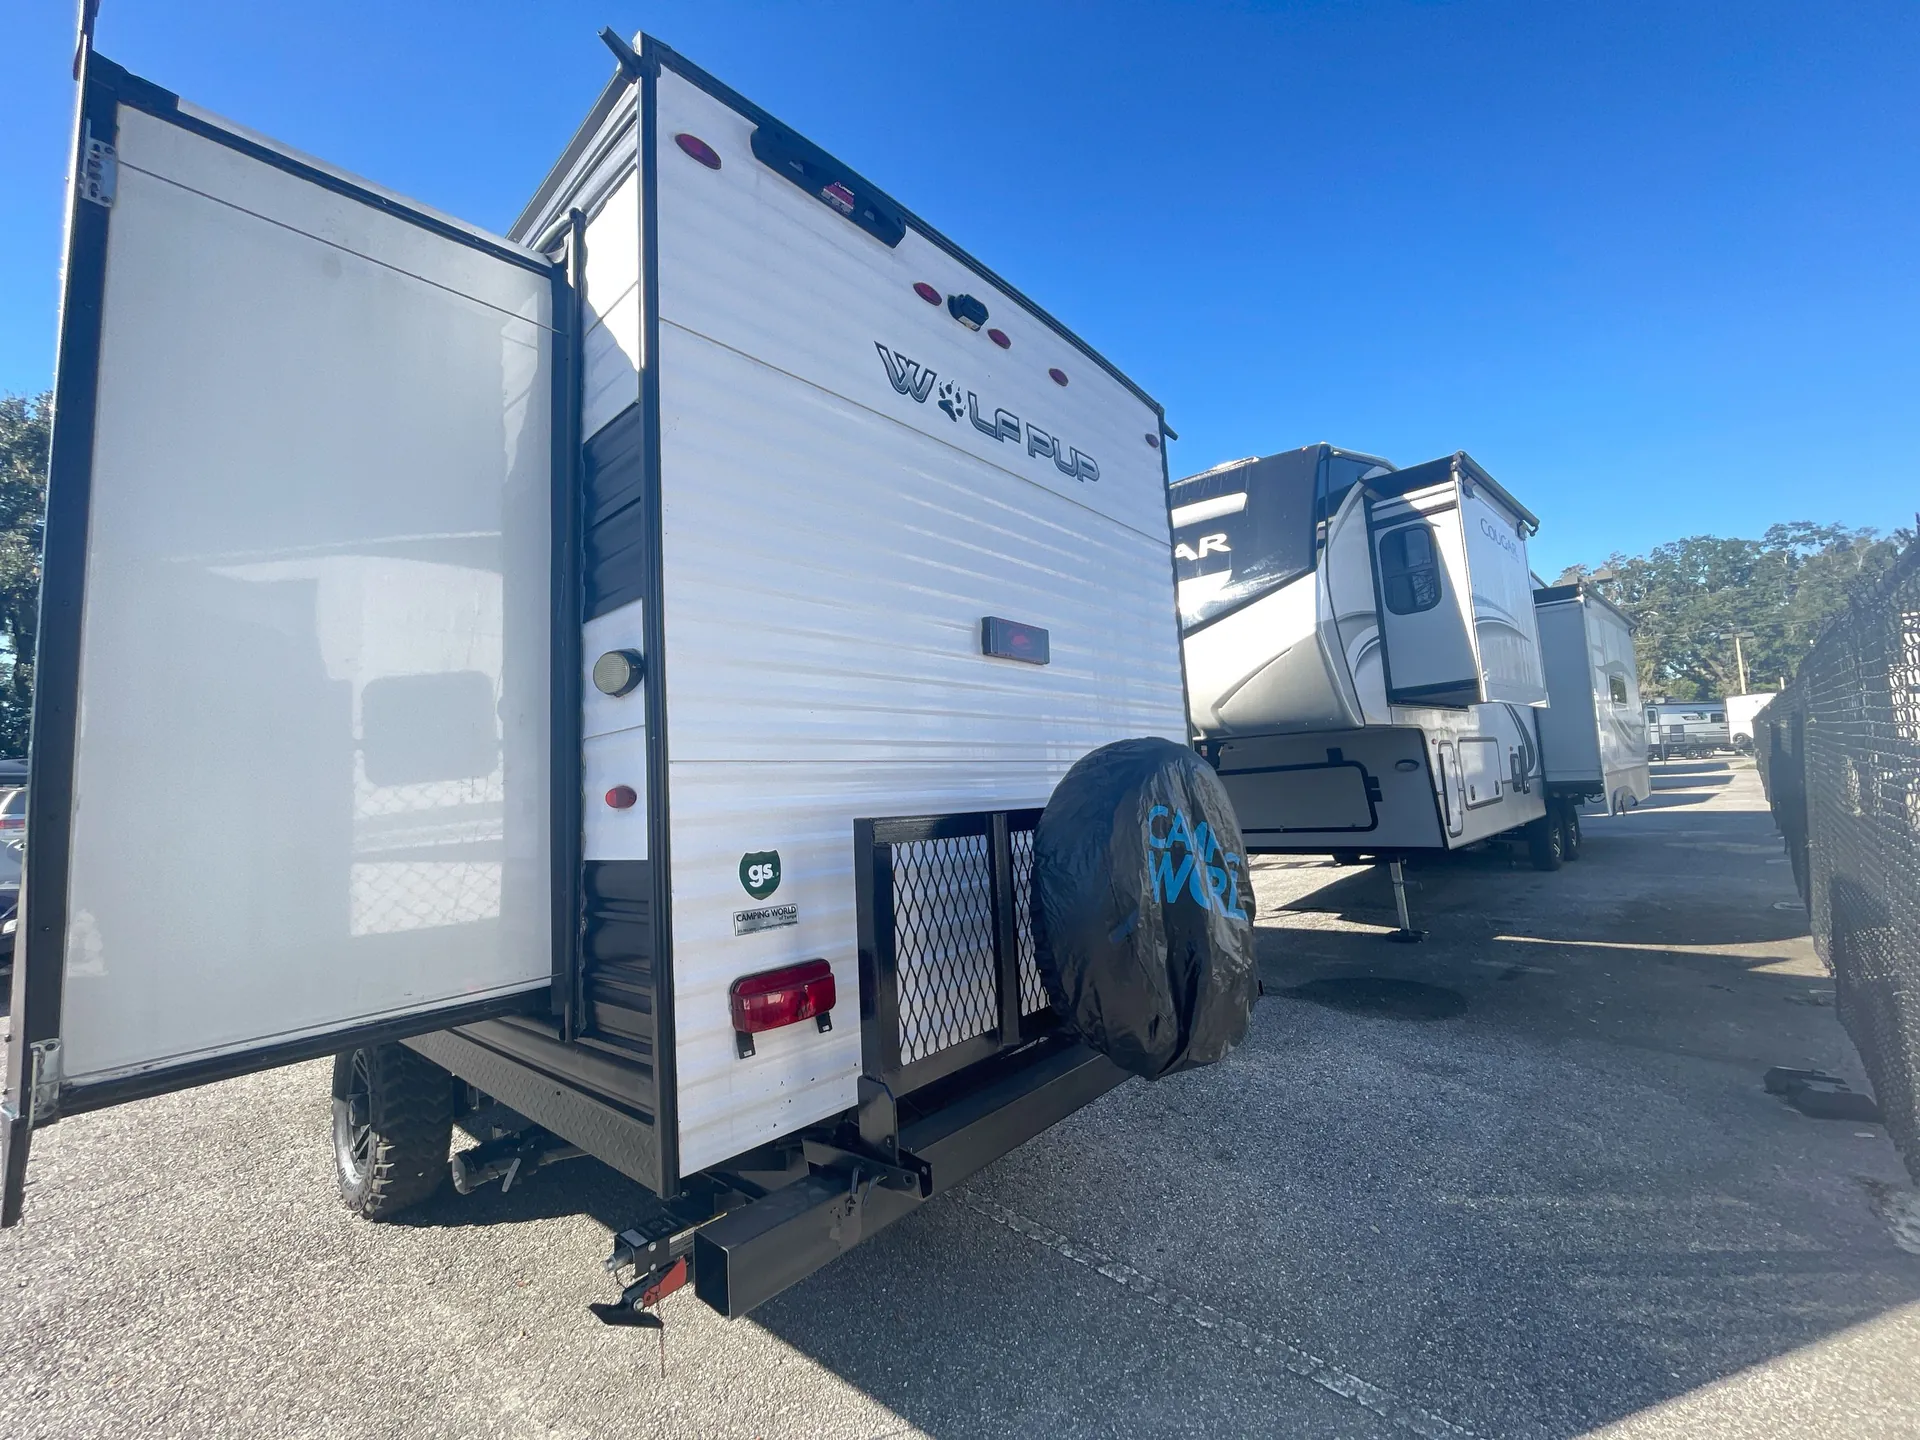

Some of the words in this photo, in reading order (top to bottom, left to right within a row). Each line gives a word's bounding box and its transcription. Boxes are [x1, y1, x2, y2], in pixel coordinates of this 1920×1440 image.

[874, 341, 1021, 443] WLF
[1026, 422, 1099, 482] PUP
[748, 863, 773, 887] gs
[736, 909, 770, 922] CAMPING
[771, 906, 796, 916] WORLD
